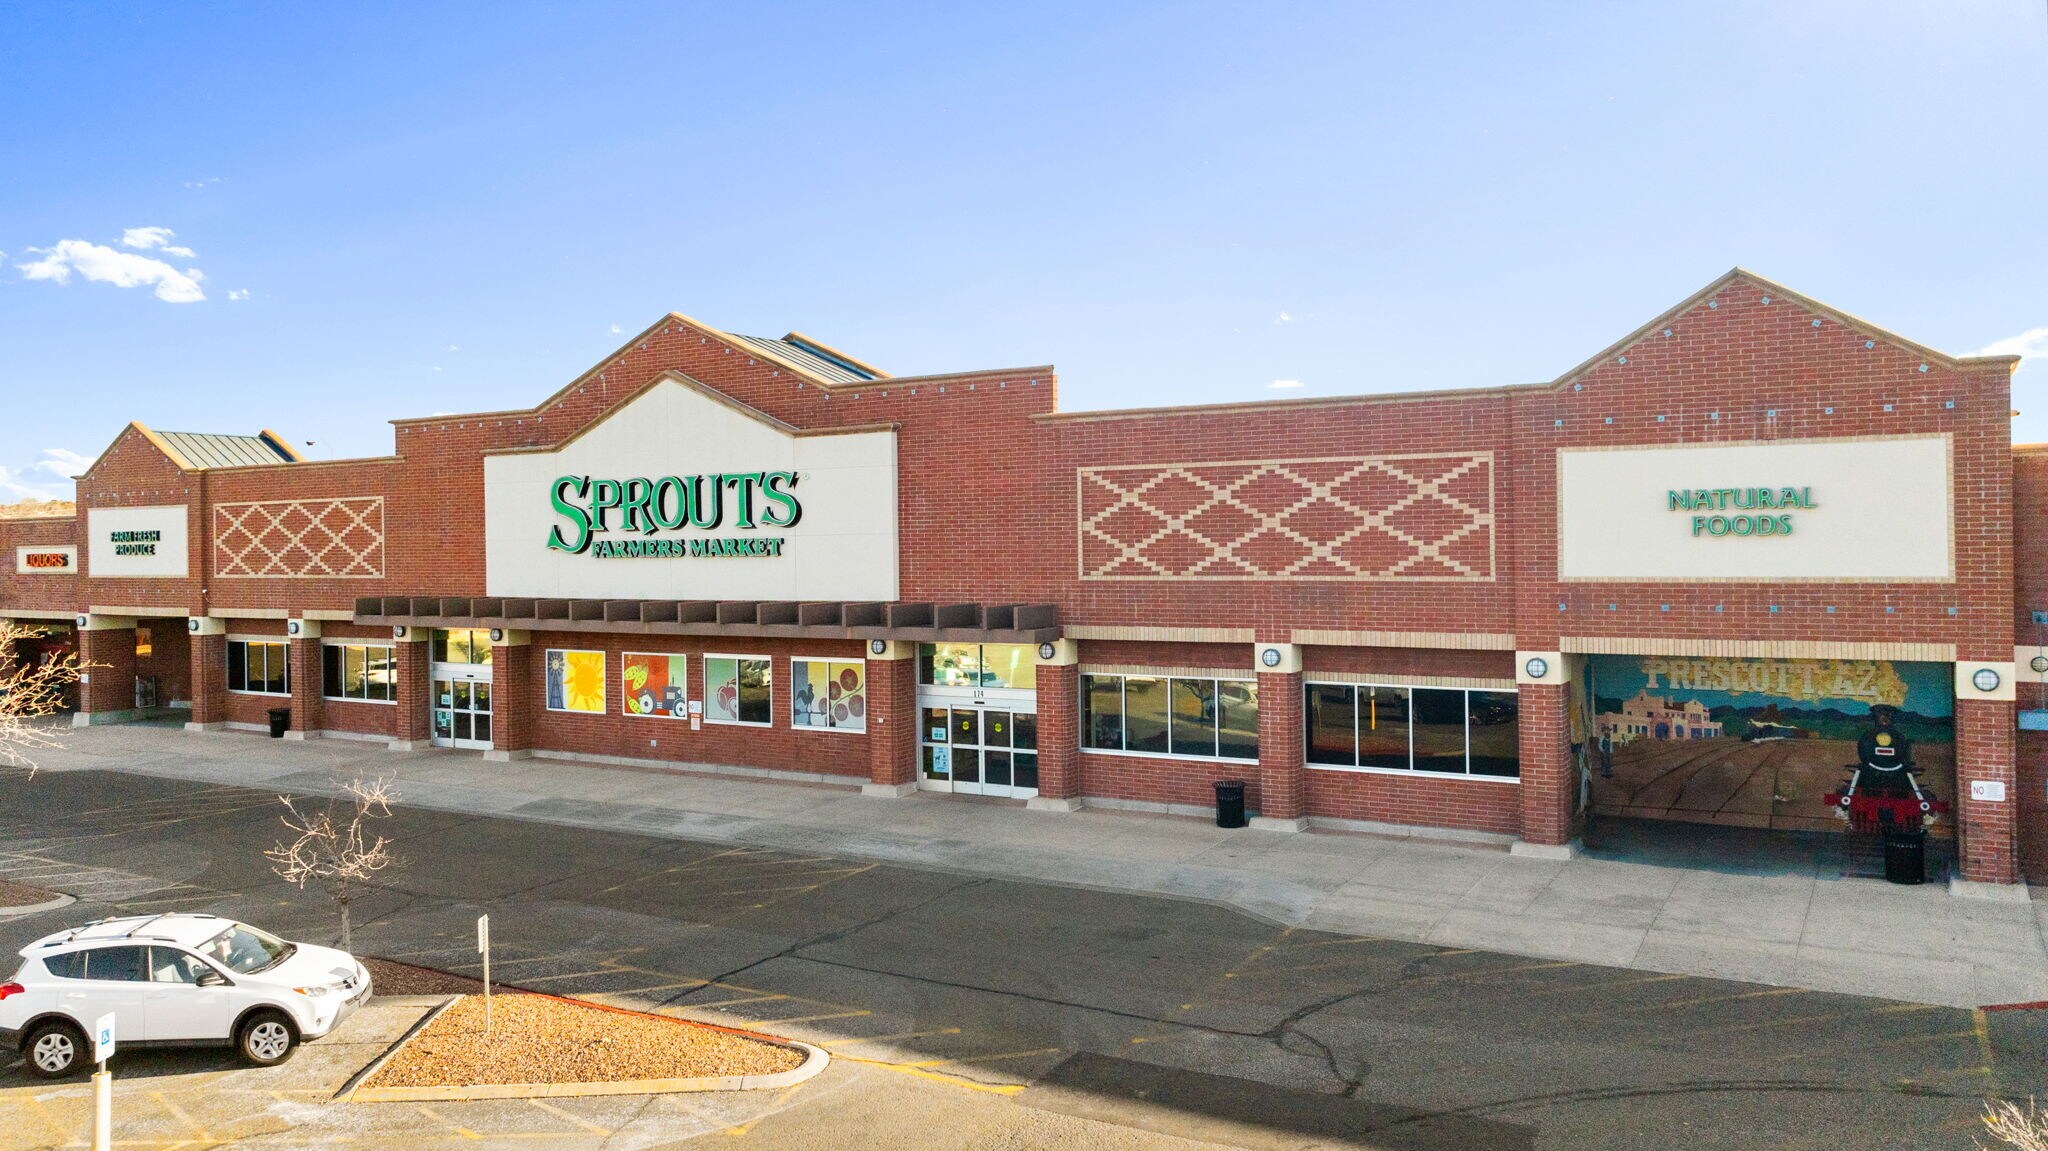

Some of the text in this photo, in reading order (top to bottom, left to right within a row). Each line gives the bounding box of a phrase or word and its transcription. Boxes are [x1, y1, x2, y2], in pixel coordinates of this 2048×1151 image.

[1667, 486, 1819, 511] NATURAL
[546, 471, 801, 554] SPROUTS
[111, 530, 159, 542] FARM FRESH
[1691, 514, 1794, 537] FOODS
[115, 543, 154, 555] PRODUCE
[592, 537, 785, 558] FARMERS MARKET
[26, 553, 67, 567] LIQUORS
[1832, 662, 1877, 697] AZ
[1973, 786, 1985, 795] NO
